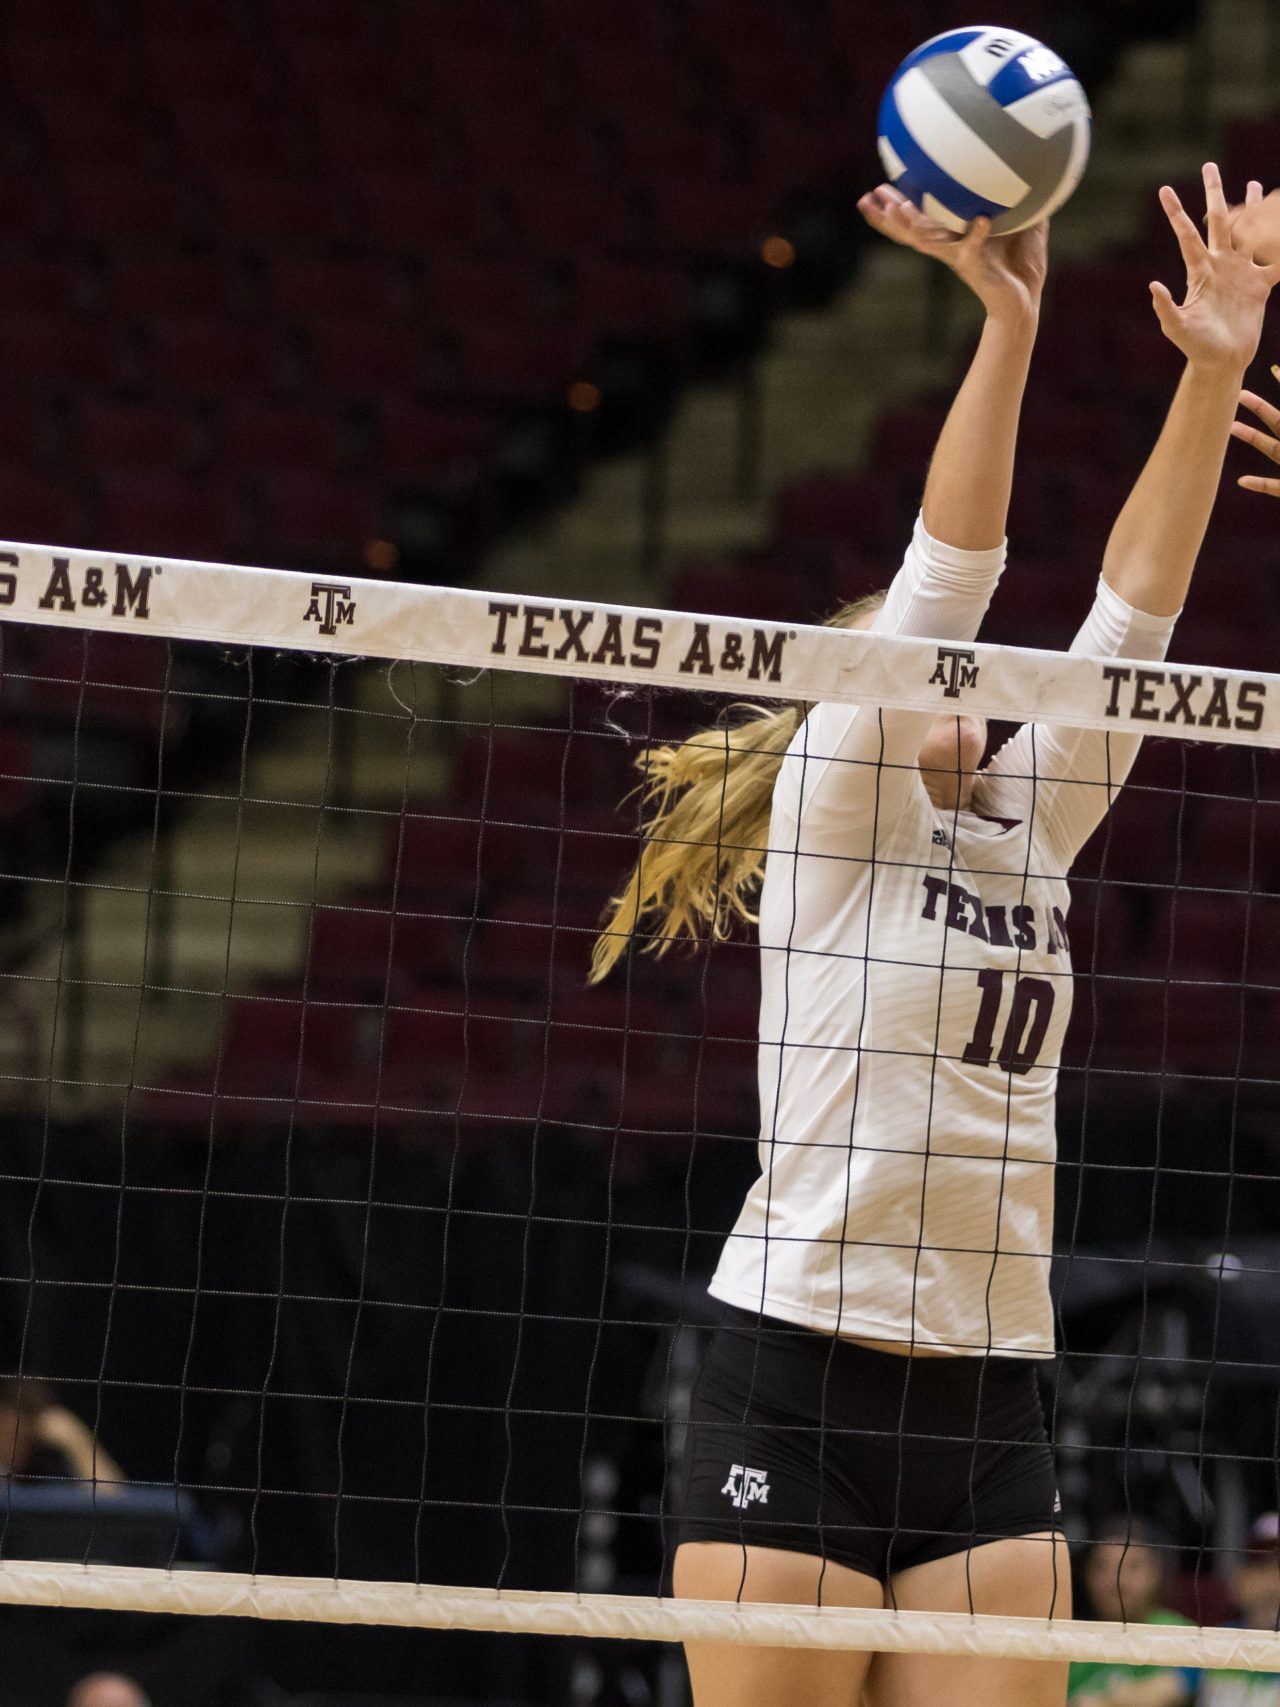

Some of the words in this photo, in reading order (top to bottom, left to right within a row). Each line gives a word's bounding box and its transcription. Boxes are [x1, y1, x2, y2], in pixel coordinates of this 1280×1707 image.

[38, 557, 152, 619] A&M
[488, 601, 663, 669] TEXAS
[679, 622, 788, 682] A&M
[1102, 665, 1267, 731] TEXAS
[961, 968, 1056, 1075] 10
